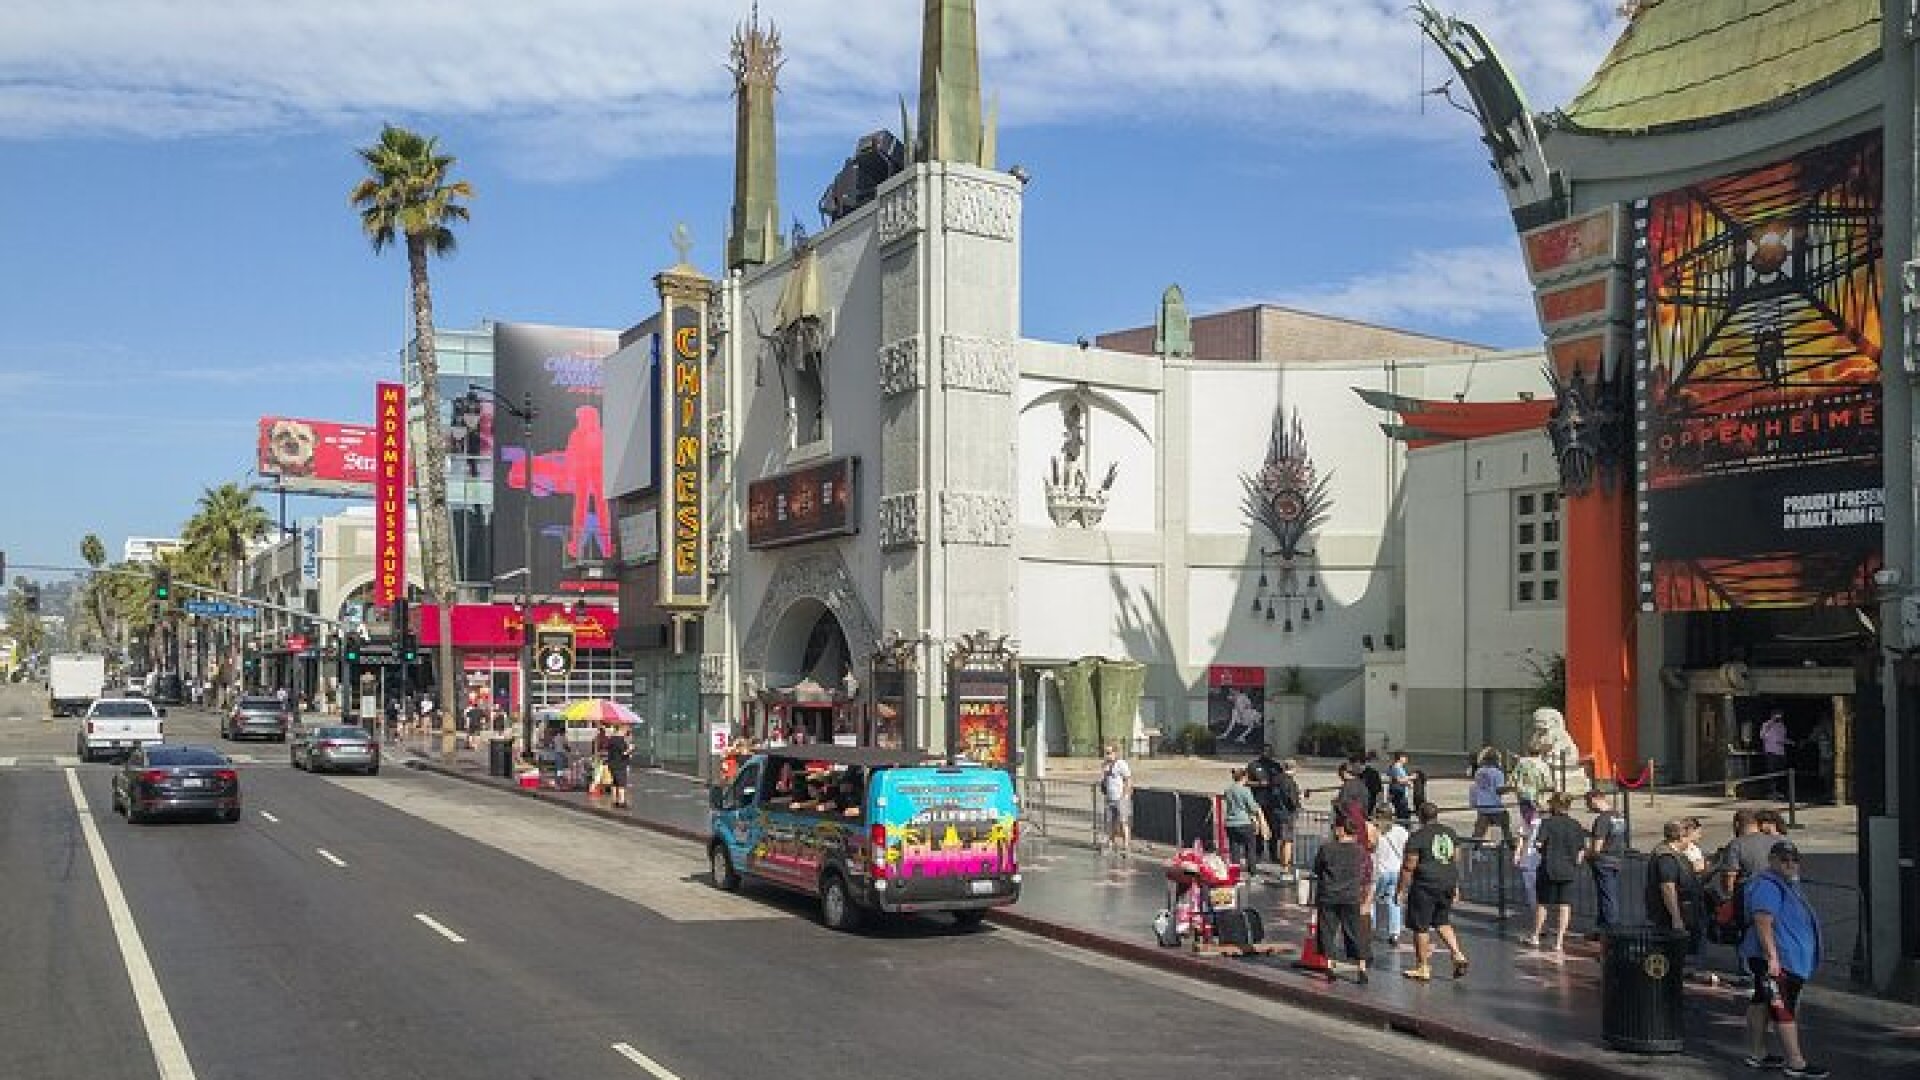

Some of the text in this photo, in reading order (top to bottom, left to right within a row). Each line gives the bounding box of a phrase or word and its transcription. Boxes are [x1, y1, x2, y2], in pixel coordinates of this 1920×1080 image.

[383, 389, 399, 601] MADAME TUSSAUDS
[675, 327, 700, 575] CHINESE
[1783, 494, 1837, 513] PROUDLY
[714, 732, 726, 750] 3
